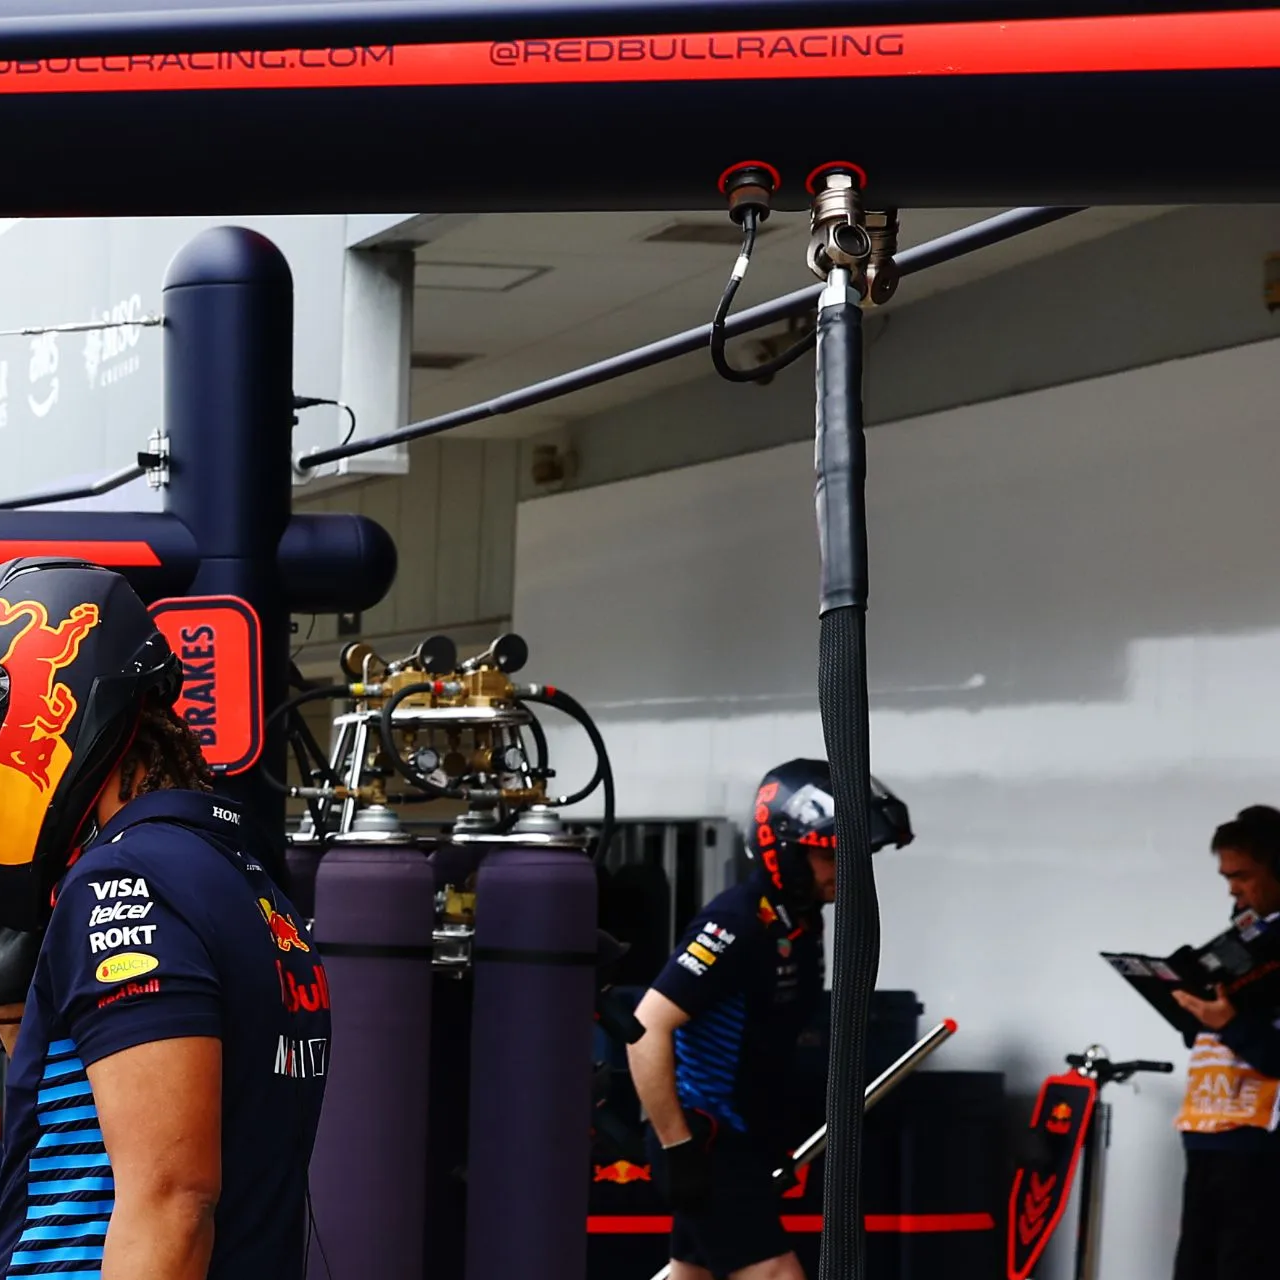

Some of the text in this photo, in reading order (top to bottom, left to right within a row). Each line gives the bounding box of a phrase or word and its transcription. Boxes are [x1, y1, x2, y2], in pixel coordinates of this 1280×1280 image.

[489, 33, 904, 66] @REDBULLRACING
[212, 805, 241, 826] HON
[87, 877, 150, 901] VISA
[88, 900, 154, 928] telcel
[89, 924, 157, 954] ROKT
